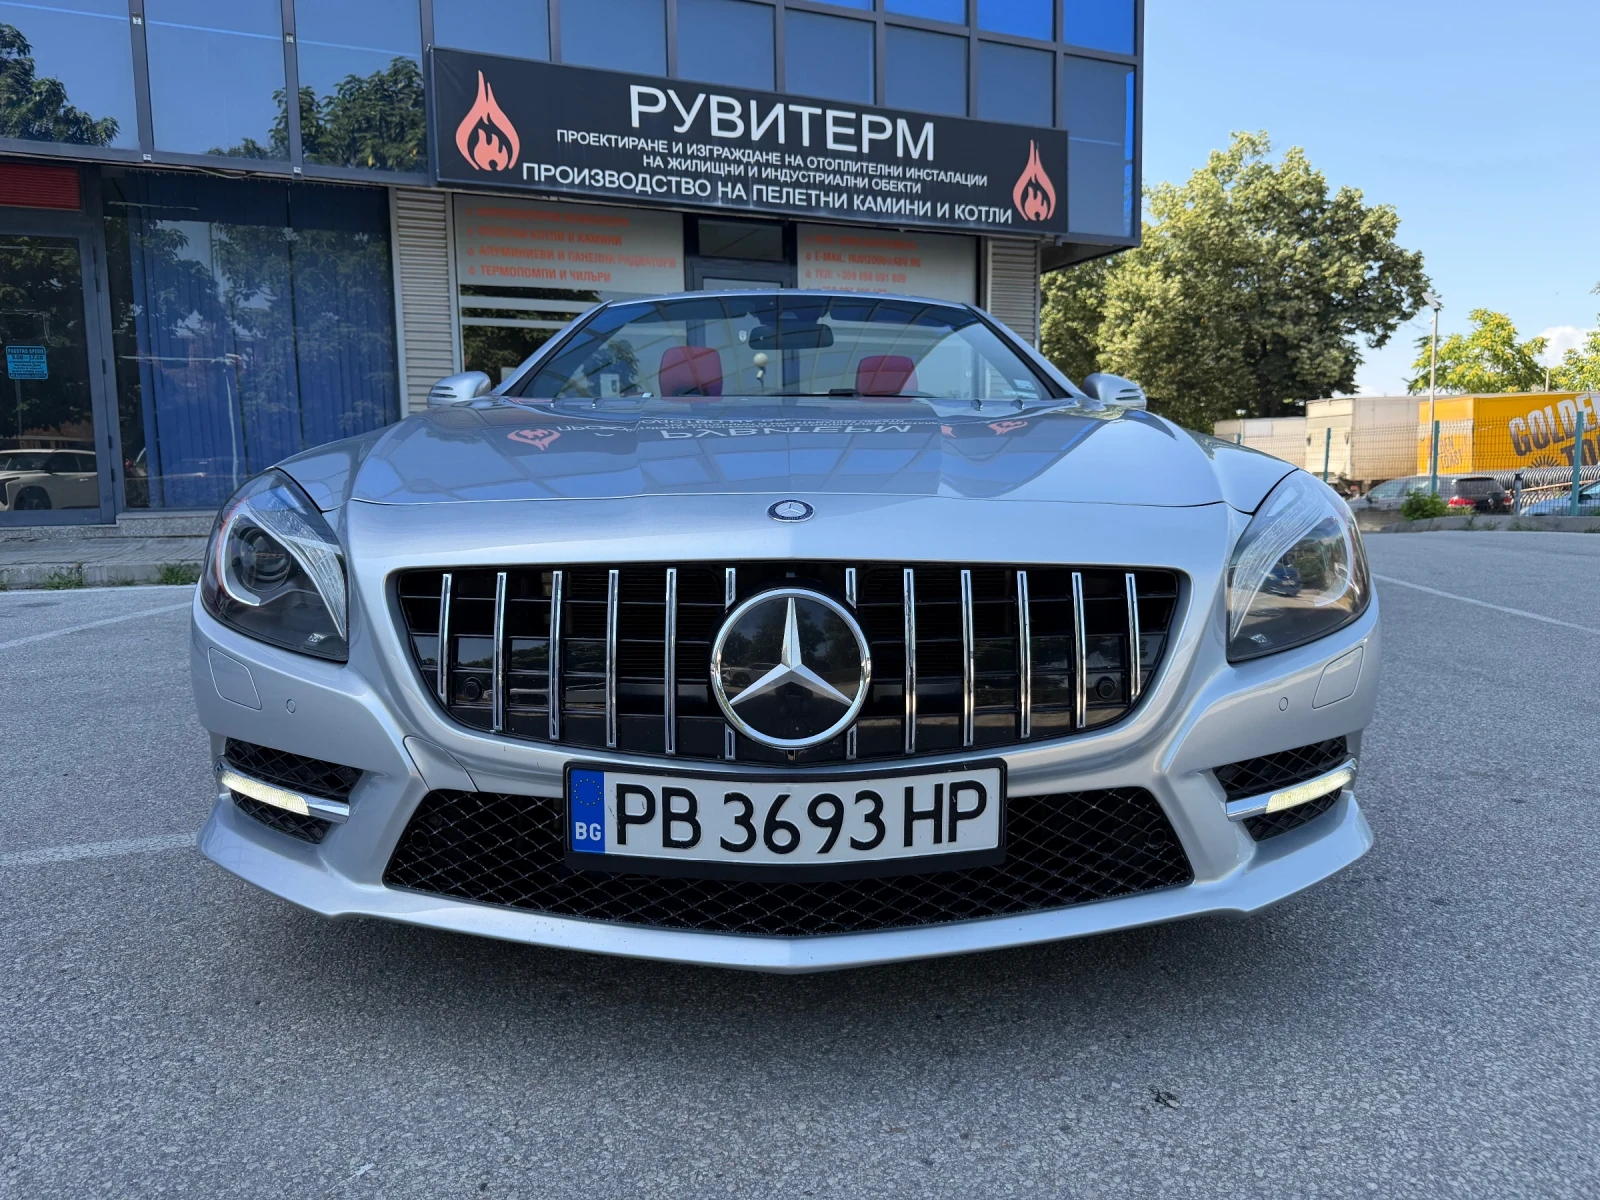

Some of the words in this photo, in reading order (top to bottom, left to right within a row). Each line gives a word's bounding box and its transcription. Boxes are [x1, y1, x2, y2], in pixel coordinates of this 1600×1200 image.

[630, 85, 933, 161] РУВИТЕРМ
[557, 129, 668, 153] ПРОЕКТИРАНЕ
[672, 142, 682, 154] И
[687, 143, 781, 165] ИЗГРАЖДАНЕ
[785, 154, 804, 167] НА
[807, 156, 902, 177] ОТОПЛИТЕЛНИ
[906, 167, 987, 187] ИНСТАЛАЦИИ
[643, 154, 664, 168] НА
[667, 157, 744, 177] ЖИЛИЩНИ
[748, 165, 758, 178] И
[762, 167, 868, 189] ИНДУСТРИАЛНИ
[872, 178, 921, 194] ОБЕКТИ
[523, 162, 711, 196] ПРОИЗВОДСТВО
[718, 181, 747, 200] НА
[753, 184, 847, 209] ПЕЛЕТНИ
[854, 194, 931, 217] КАМИНИ
[937, 202, 949, 218] И
[955, 204, 1012, 224] КОТЛИ
[479, 245, 555, 260] АЛУМИНИЕВИ
[558, 250, 565, 262] И
[568, 250, 616, 265] ПАНЕЛНИ
[480, 265, 557, 279] ТЕРМОПОМПИ
[560, 269, 567, 280] И
[570, 270, 611, 283] ЧИЛЪРИ
[575, 822, 601, 841] BG
[616, 784, 701, 849] PB
[719, 790, 886, 854] 3693
[903, 780, 988, 847] HP
